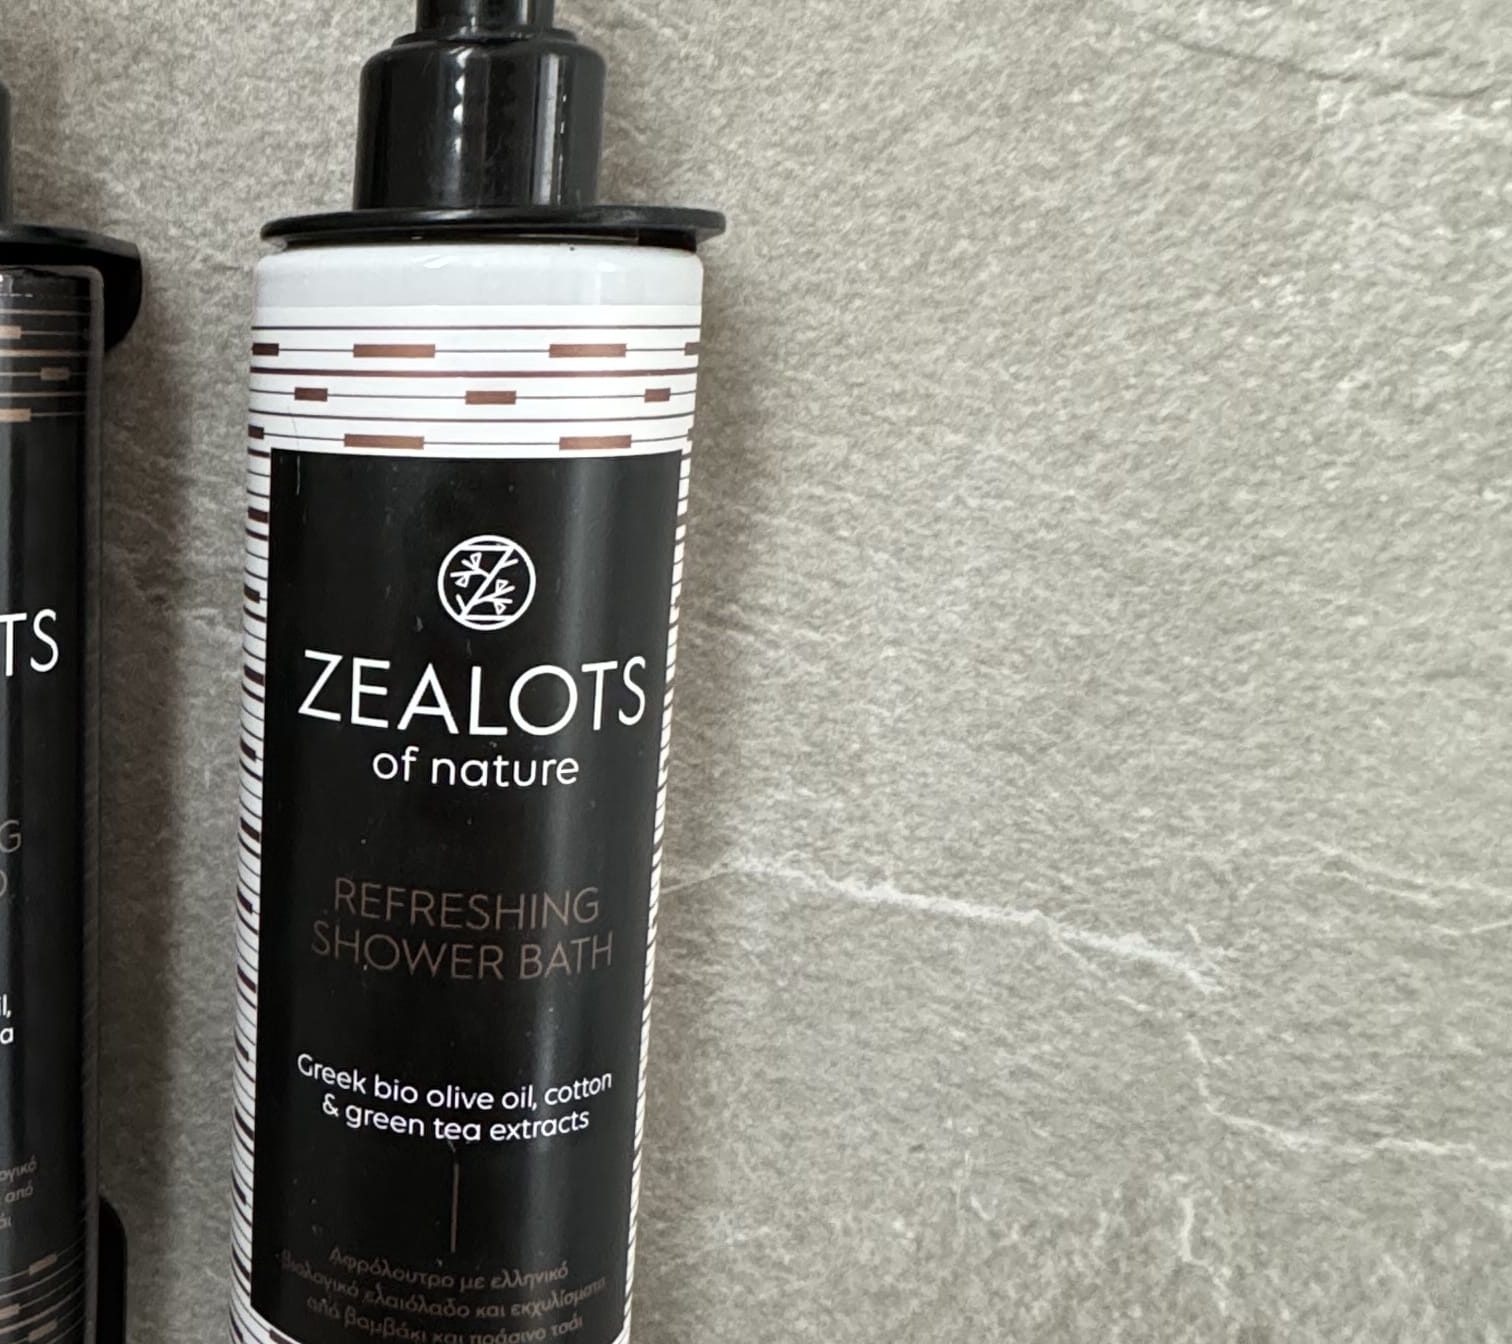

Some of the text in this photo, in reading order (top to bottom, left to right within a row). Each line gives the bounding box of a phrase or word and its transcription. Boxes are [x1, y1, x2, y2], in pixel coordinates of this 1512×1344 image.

[298, 650, 646, 736] ZEALOTS
[372, 746, 579, 787] of nature
[334, 877, 599, 931] REFRESHING
[311, 920, 614, 980] SHOWER BATH
[298, 1053, 612, 1111] Greek bio olive oil, cotton
[321, 1094, 589, 1141] & green tea extracts
[5, 1180, 34, 1203] από
[329, 1245, 568, 1293] Αφρόλουτρο με ελληνικό
[363, 1282, 470, 1318] ελαιόλαδο
[475, 1303, 505, 1318] και
[344, 1305, 426, 1344] βαμβάκι
